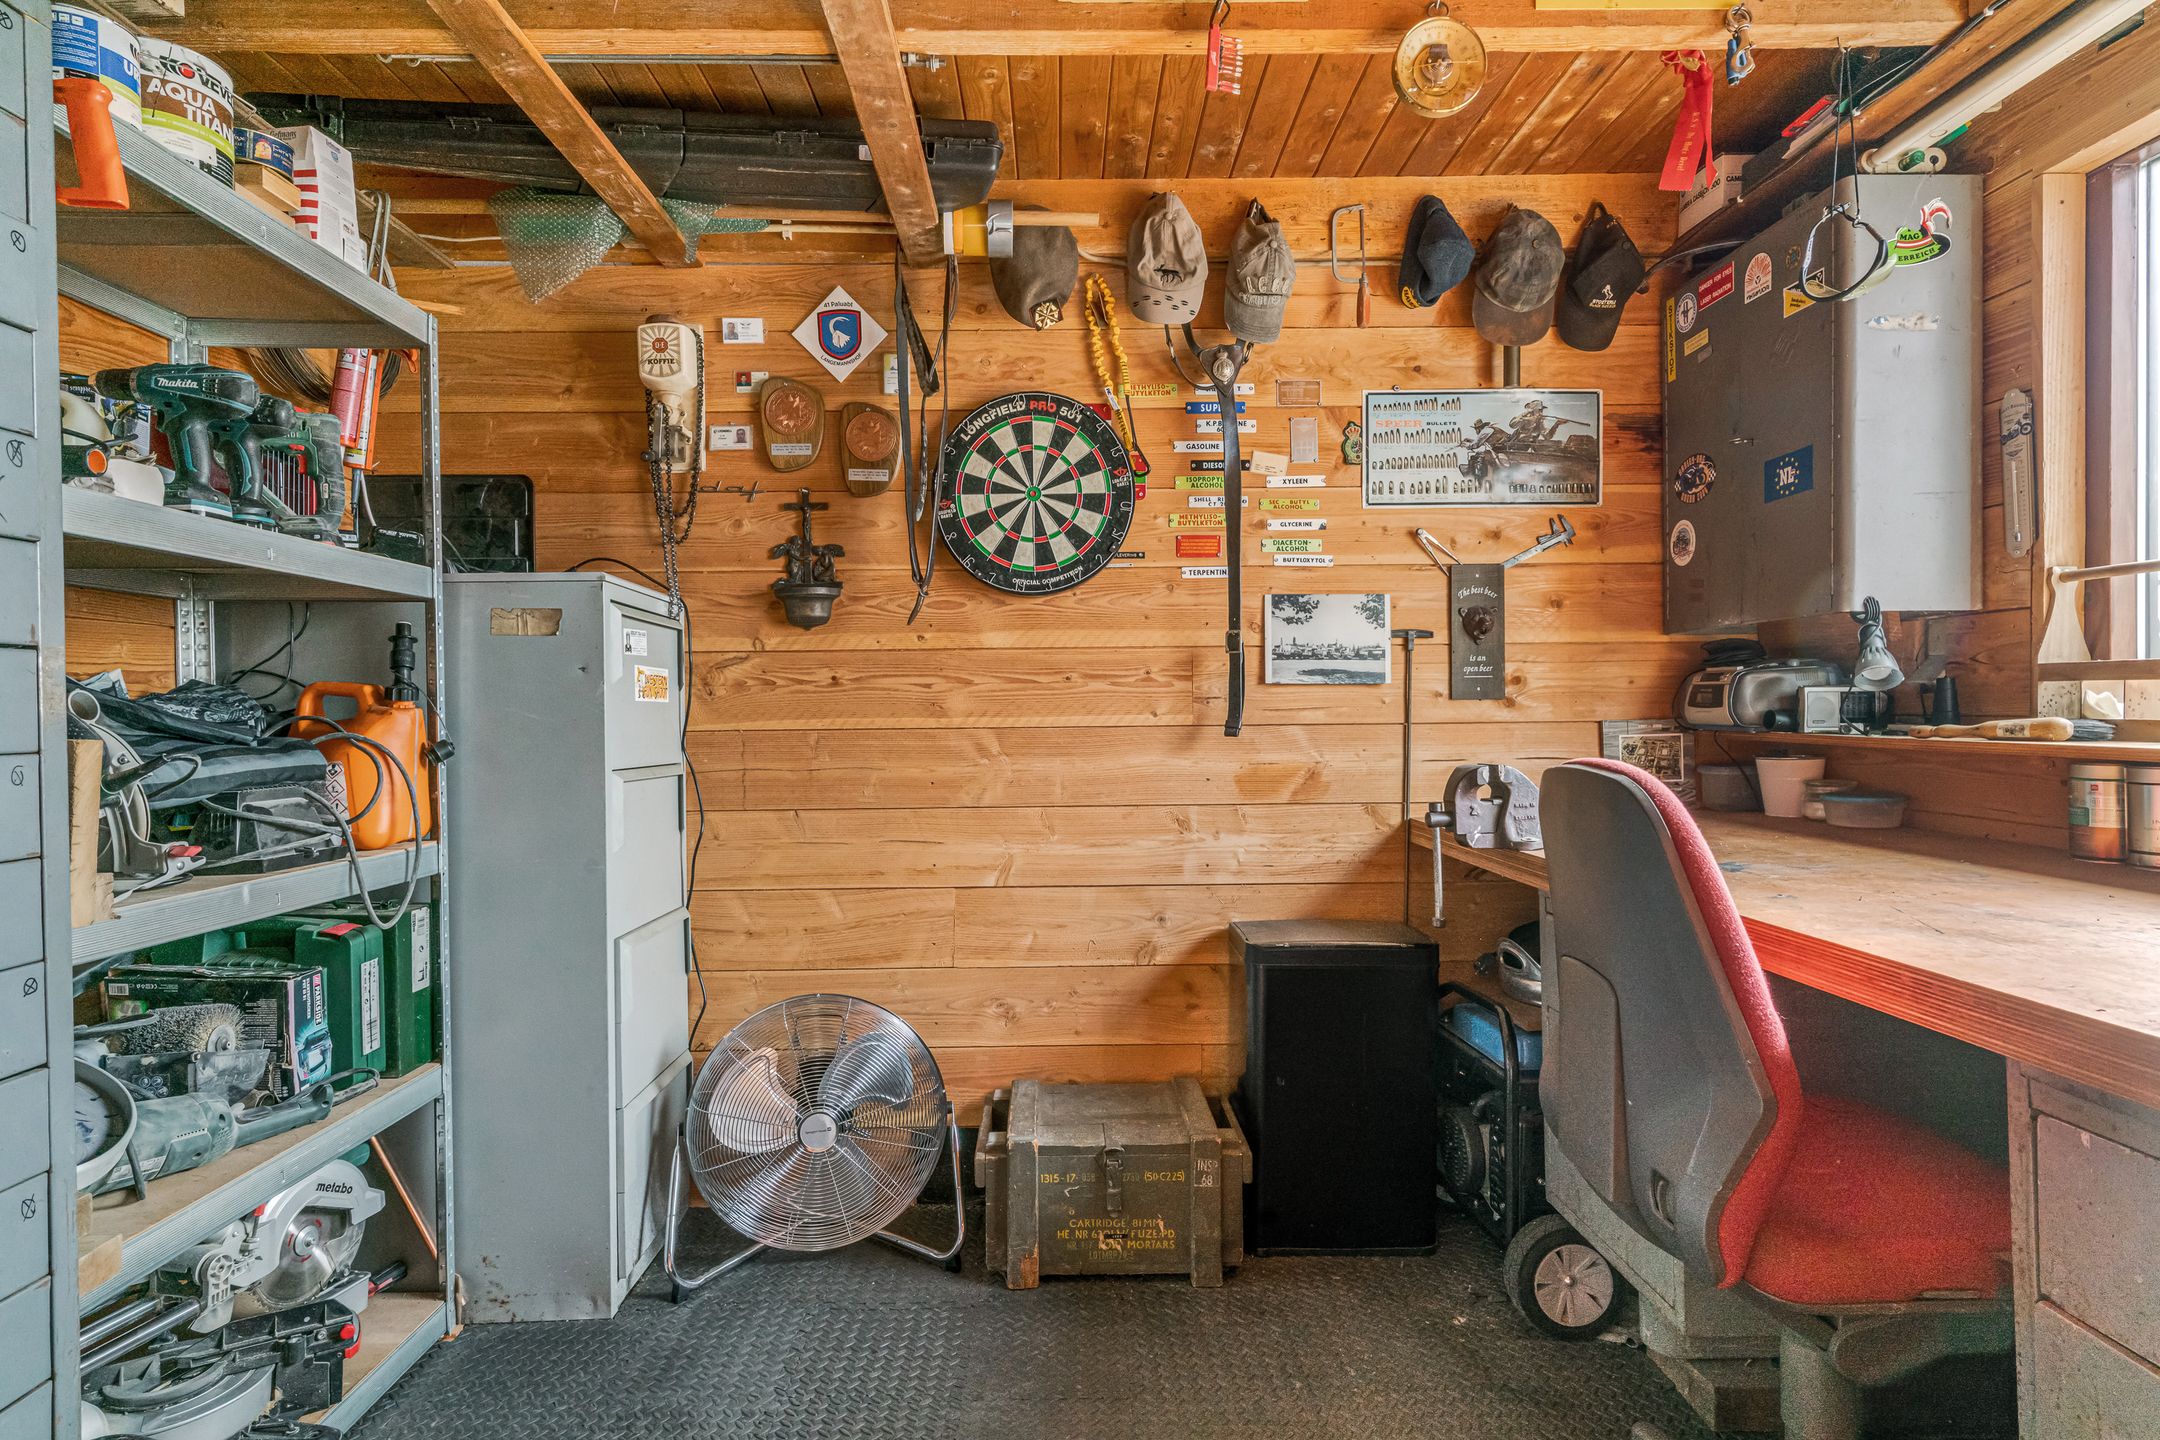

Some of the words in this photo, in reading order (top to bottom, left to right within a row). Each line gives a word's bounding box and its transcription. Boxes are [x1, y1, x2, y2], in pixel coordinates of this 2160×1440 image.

[147, 78, 217, 117] AQUA
[183, 103, 233, 143] TITAN
[1726, 175, 1742, 183] CAM
[1898, 247, 1936, 261] ERREICH
[647, 357, 675, 365] KOFFIE
[820, 353, 862, 366] LANGEMANNSHOF
[157, 377, 199, 389] Makita
[960, 400, 1026, 441] LONGFIELD
[1029, 400, 1057, 412] PRO
[1059, 406, 1083, 423] 501
[1376, 419, 1422, 428] SPEER
[1458, 587, 1470, 599] The
[1471, 585, 1484, 594] best
[1485, 586, 1498, 599] beer
[1469, 654, 1476, 662] is
[1463, 665, 1479, 674] open
[1479, 664, 1493, 672] beer
[314, 985, 322, 1026] PARKSIDE
[1201, 1175, 1213, 1186] 68
[315, 1182, 353, 1194] metabo
[1069, 1218, 1126, 1228] CARTRIDGE
[1057, 1229, 1069, 1239] HE
[1075, 1229, 1088, 1239] NR
[1131, 1228, 1158, 1238] FUZE
[1127, 1240, 1176, 1249] MORTARS
